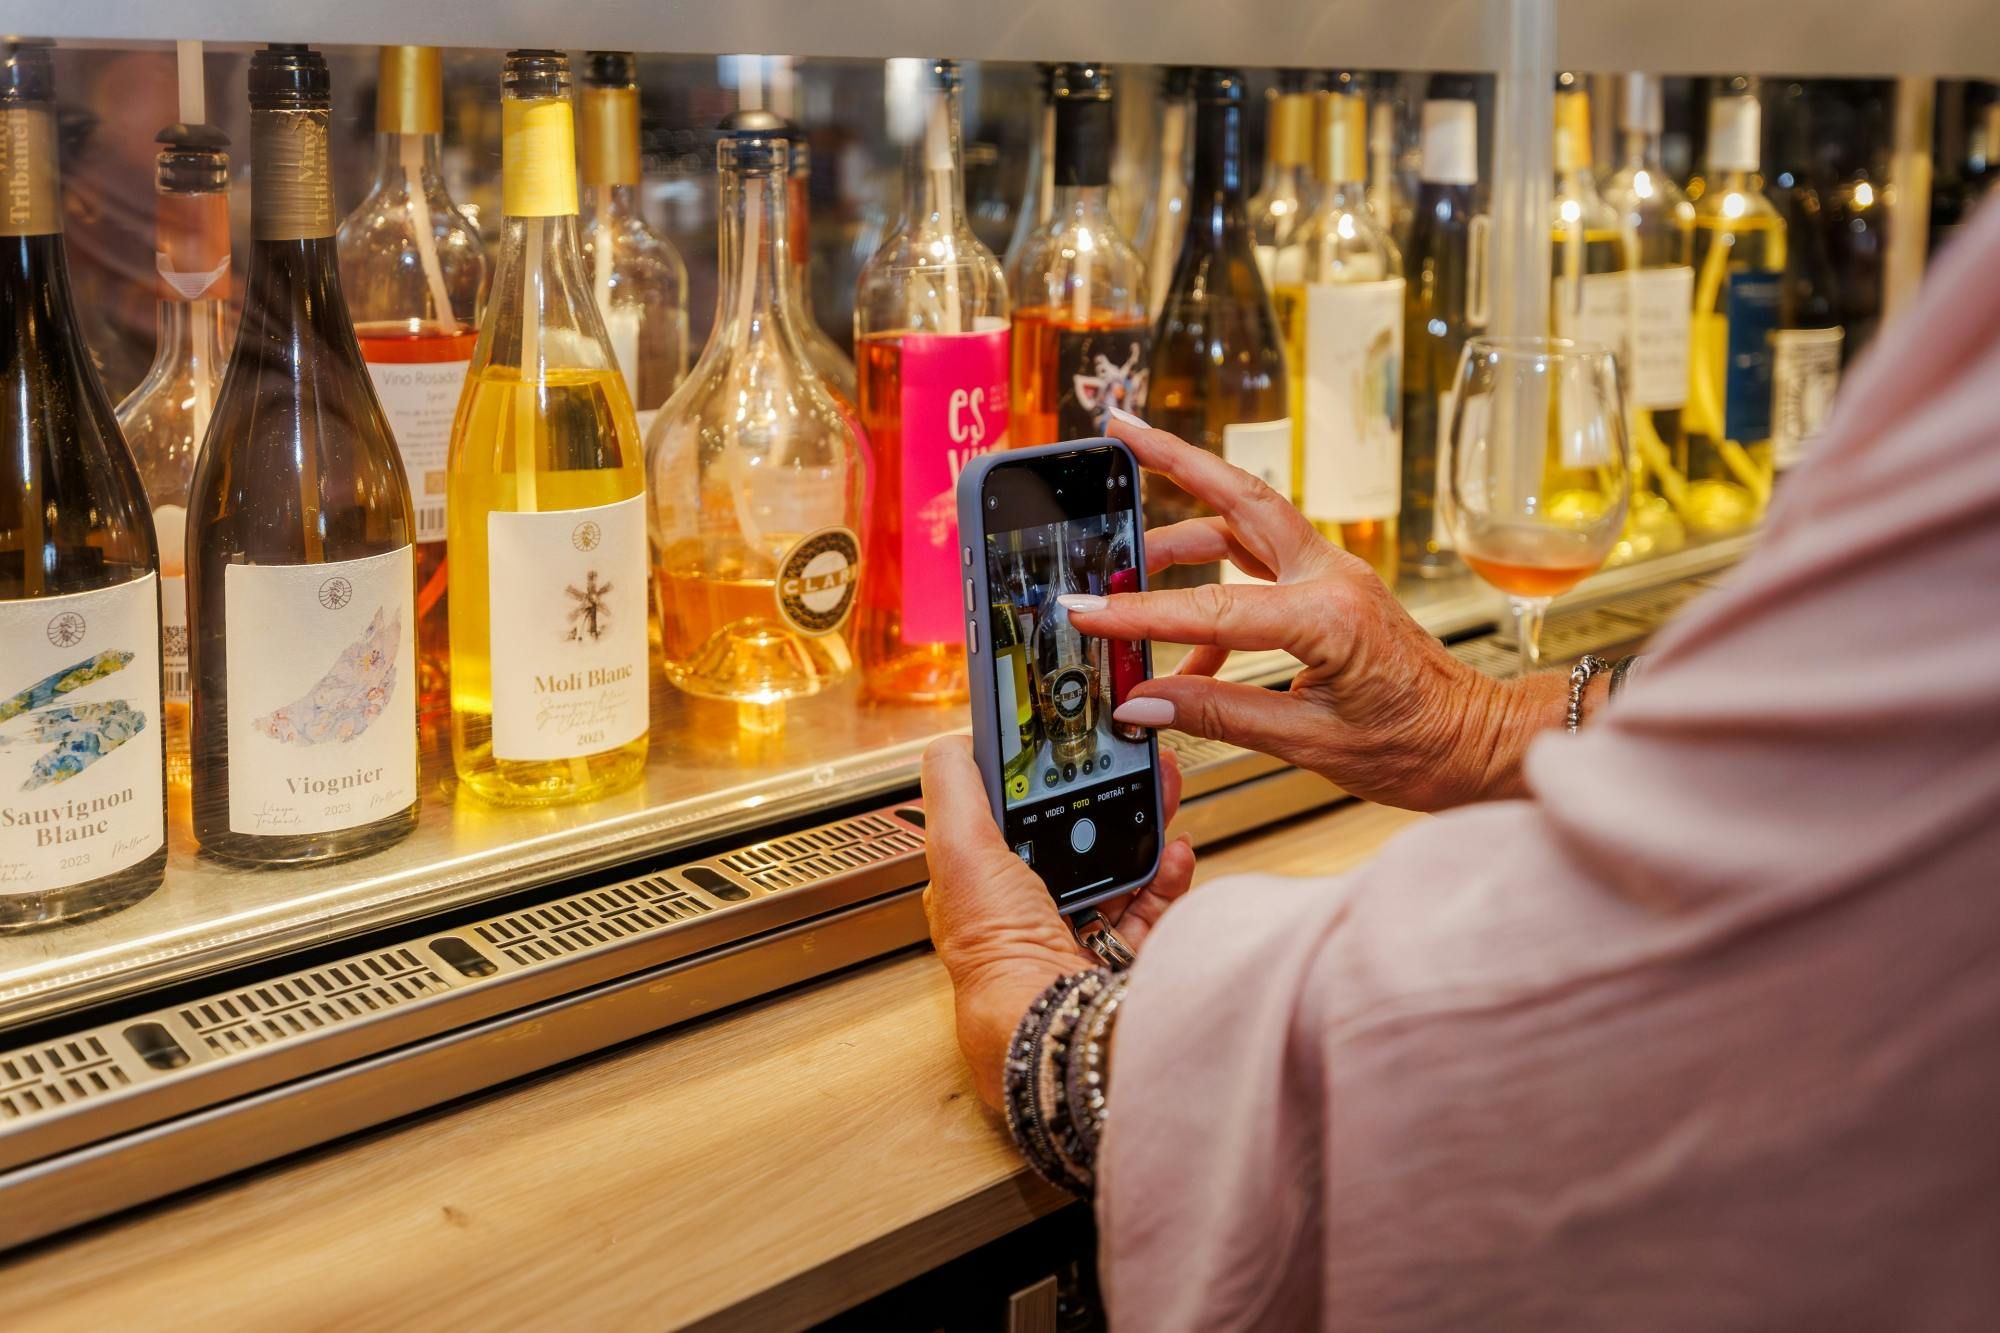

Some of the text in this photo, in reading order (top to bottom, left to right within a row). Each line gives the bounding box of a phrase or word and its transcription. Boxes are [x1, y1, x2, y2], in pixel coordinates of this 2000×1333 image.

[383, 370, 411, 386] Vino
[948, 387, 986, 443] es
[533, 664, 633, 693] Molí Blanc
[577, 730, 605, 745] 2023
[287, 768, 383, 795] Viognier
[2, 788, 133, 827] Sauvignon
[324, 803, 352, 816] 2023
[1045, 806, 1065, 818] VIDEO
[1072, 798, 1090, 810] FOTO
[1097, 786, 1125, 802] PORTRÄT
[37, 818, 108, 847] Blanc
[59, 853, 91, 870] 2023
